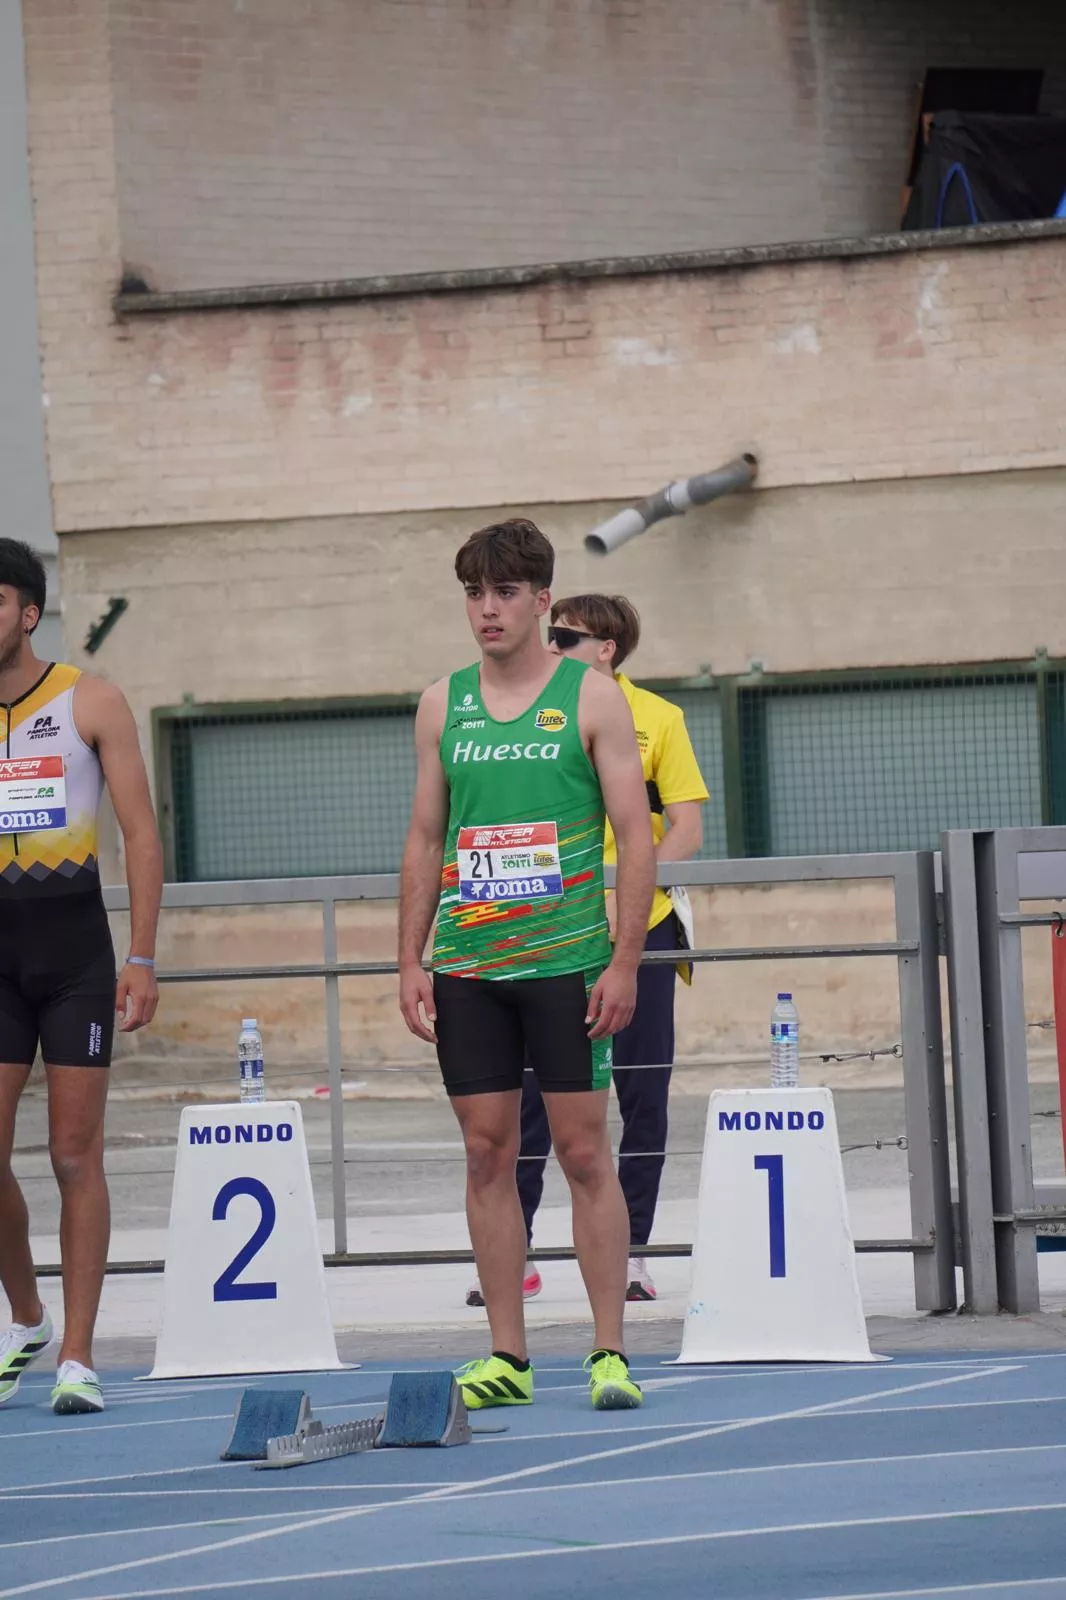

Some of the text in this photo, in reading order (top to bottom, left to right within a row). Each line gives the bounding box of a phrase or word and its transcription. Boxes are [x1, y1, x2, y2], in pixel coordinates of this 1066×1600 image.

[27, 725, 60, 736] PAMPLONA
[34, 716, 52, 728] PA
[453, 740, 561, 764] Huesca
[37, 786, 55, 795] PA
[0, 811, 52, 828] oma
[491, 828, 534, 840] RFEA
[470, 851, 494, 879] 21
[485, 878, 548, 900] Joma
[719, 1111, 825, 1131] MONDO
[189, 1123, 294, 1145] MONDO
[754, 1154, 786, 1278] 1
[212, 1176, 278, 1302] 2
